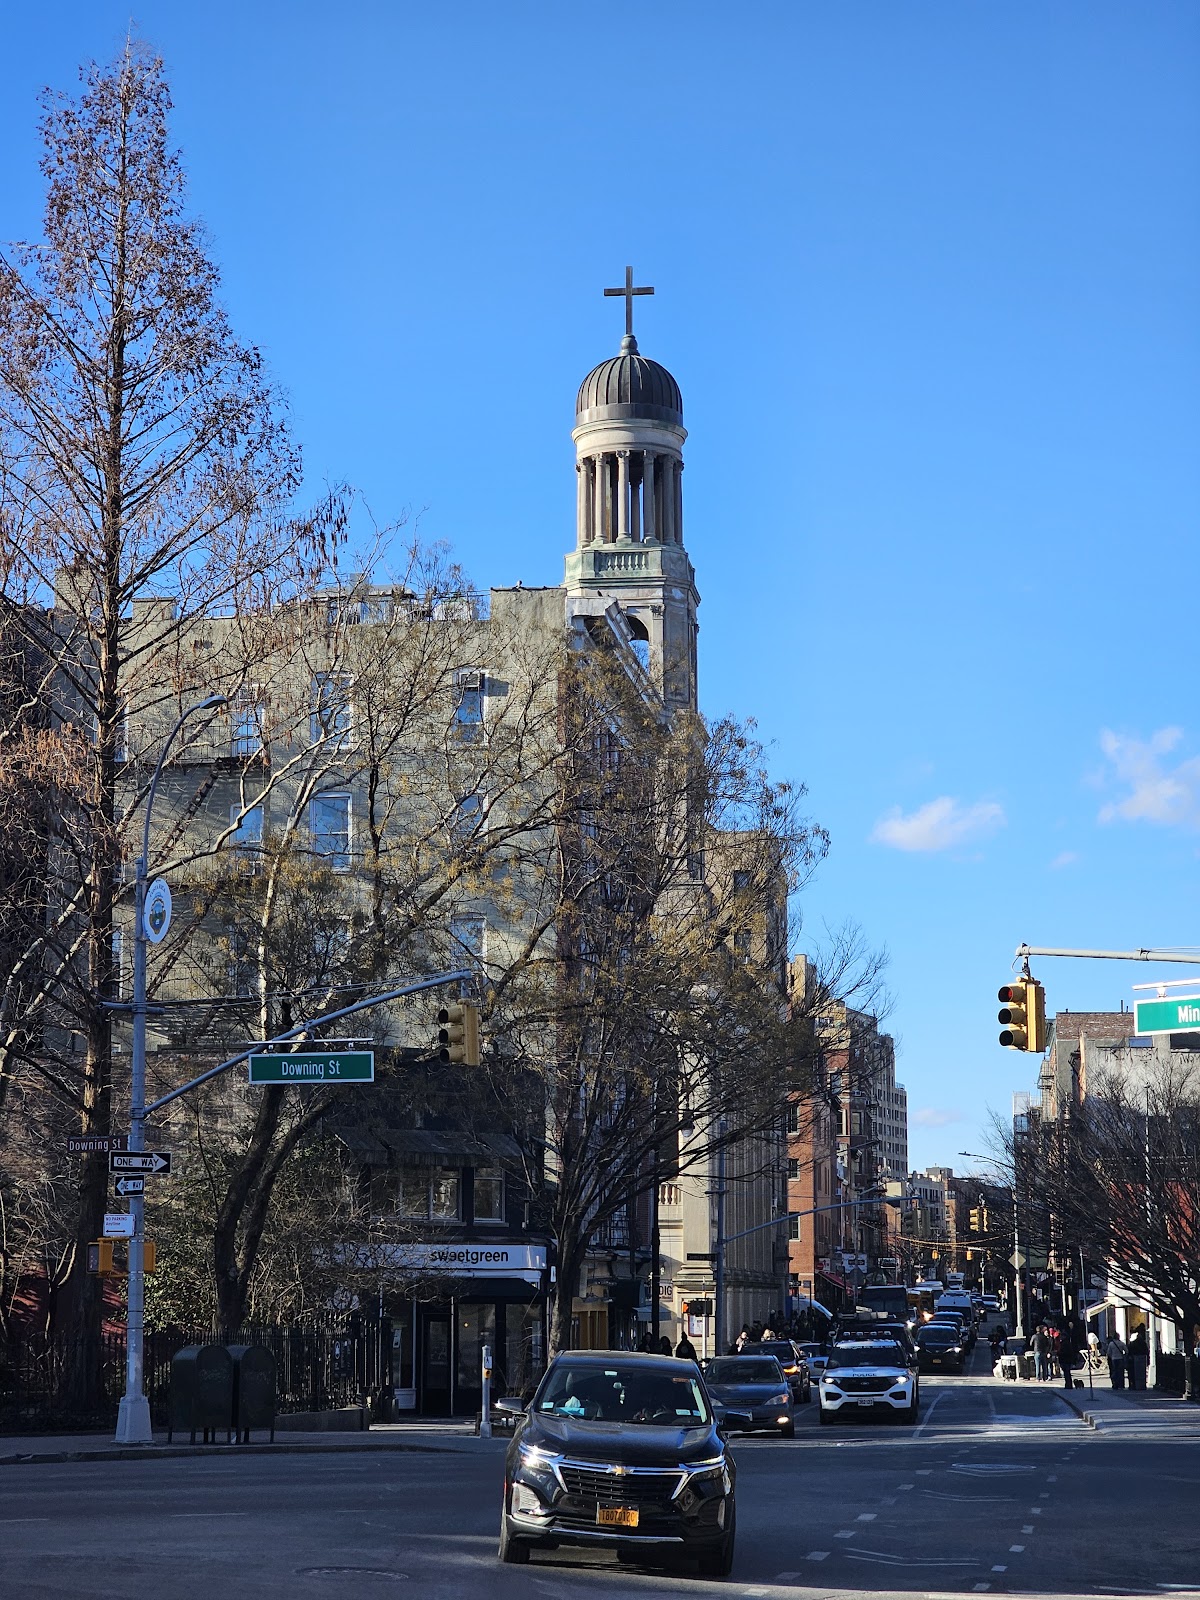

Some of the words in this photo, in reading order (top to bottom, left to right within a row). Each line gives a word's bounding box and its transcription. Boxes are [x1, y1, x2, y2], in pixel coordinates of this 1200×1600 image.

[281, 1060, 325, 1079] Downing
[328, 1060, 341, 1075] St
[69, 1139, 109, 1152] Downing
[112, 1138, 121, 1149] St
[116, 1157, 133, 1167] ONE
[141, 1158, 159, 1167] WAY
[120, 1181, 129, 1190] ONE
[132, 1181, 142, 1189] WAY
[430, 1248, 509, 1265] sweetgreen
